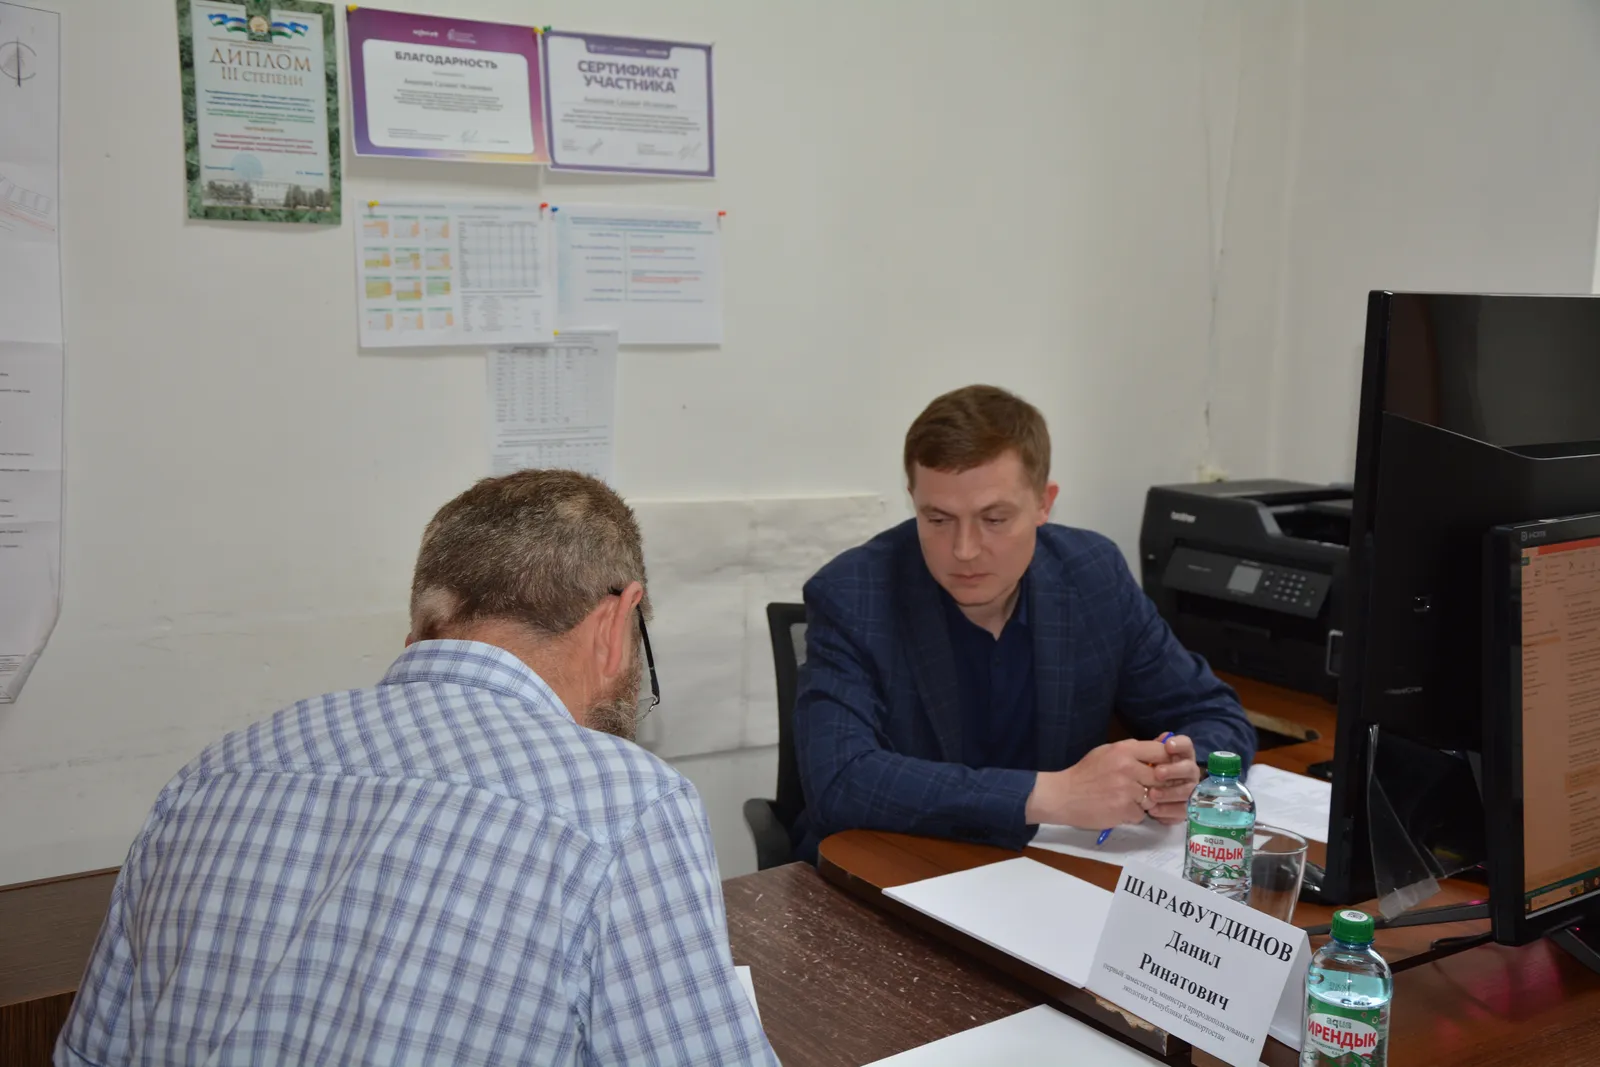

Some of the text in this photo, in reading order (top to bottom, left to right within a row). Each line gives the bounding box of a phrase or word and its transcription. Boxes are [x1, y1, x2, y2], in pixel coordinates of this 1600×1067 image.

[209, 48, 312, 72] ДИПЛОМ
[394, 51, 498, 70] БЛАГОДАРНОСТЬ
[577, 60, 680, 80] СЕРТИФИКАТ
[242, 71, 304, 87] СТЕПЕНИ
[583, 74, 676, 94] УЧАСТНИКА
[1189, 840, 1244, 862] ИРЕНДЫК
[1203, 836, 1225, 846] aqua
[1123, 874, 1294, 963] ШАРАФУТДИНОВ
[1164, 930, 1222, 970] Данил
[1138, 952, 1230, 1012] Ринатович
[1102, 963, 1125, 978] первый
[1125, 974, 1158, 995] заместитель
[1159, 991, 1188, 1010] министра
[1187, 1005, 1251, 1042] природопользования
[1148, 996, 1183, 1020] Республики
[1183, 1014, 1227, 1043] Башкортостан
[1326, 1016, 1352, 1029] aqua
[1307, 1018, 1378, 1050] ИРЕНДЫК
